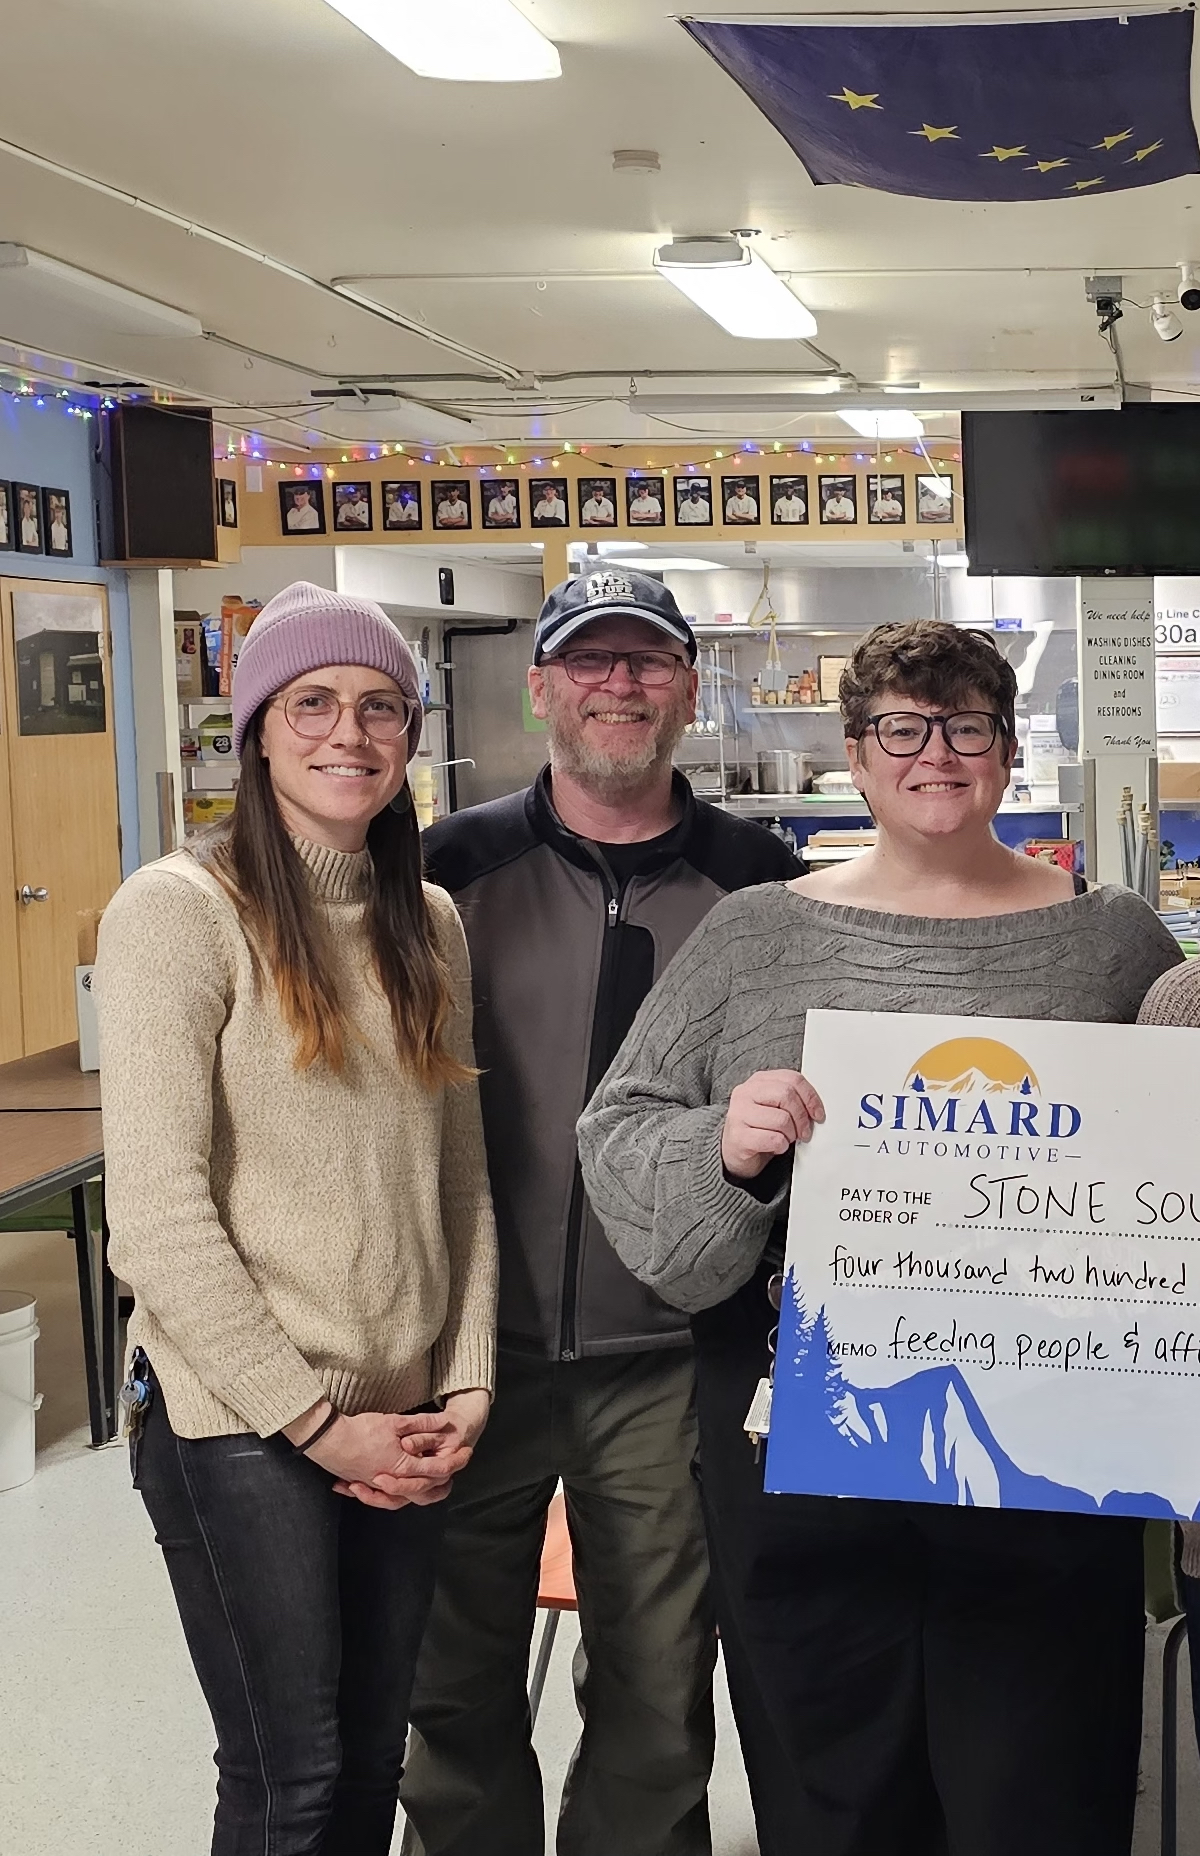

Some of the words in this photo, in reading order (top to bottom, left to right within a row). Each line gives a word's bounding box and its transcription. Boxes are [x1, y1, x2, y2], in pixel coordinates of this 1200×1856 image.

[1086, 610, 1102, 620] We
[1106, 611, 1127, 620] need
[1130, 609, 1151, 622] help
[1166, 609, 1189, 619] Line
[1087, 637, 1122, 647] WASHING
[1124, 636, 1151, 647] DISHES
[1099, 655, 1137, 666] CLEANING
[1094, 670, 1121, 680] DINING
[1123, 670, 1145, 680] ROOM
[1113, 689, 1126, 698] and
[1097, 706, 1142, 717] RESTROOMS
[215, 737, 229, 747] 28
[1103, 735, 1132, 746] Thank
[1134, 735, 1152, 748] You
[858, 1093, 1082, 1139] SIMARD
[876, 1139, 1060, 1164] AUTOMOTIVE
[840, 1188, 872, 1204] PAY
[876, 1189, 899, 1205] TO
[902, 1190, 932, 1206] THE
[963, 1173, 1110, 1225] STONE
[839, 1208, 892, 1224] ORDER
[896, 1210, 919, 1225] OF
[829, 1245, 883, 1278] four
[893, 1249, 1009, 1285] thousand
[1029, 1254, 1075, 1284] two
[1086, 1255, 1187, 1294] hundred
[826, 1341, 877, 1358] MEMO
[888, 1315, 995, 1371] feeding
[1016, 1329, 1110, 1373] people
